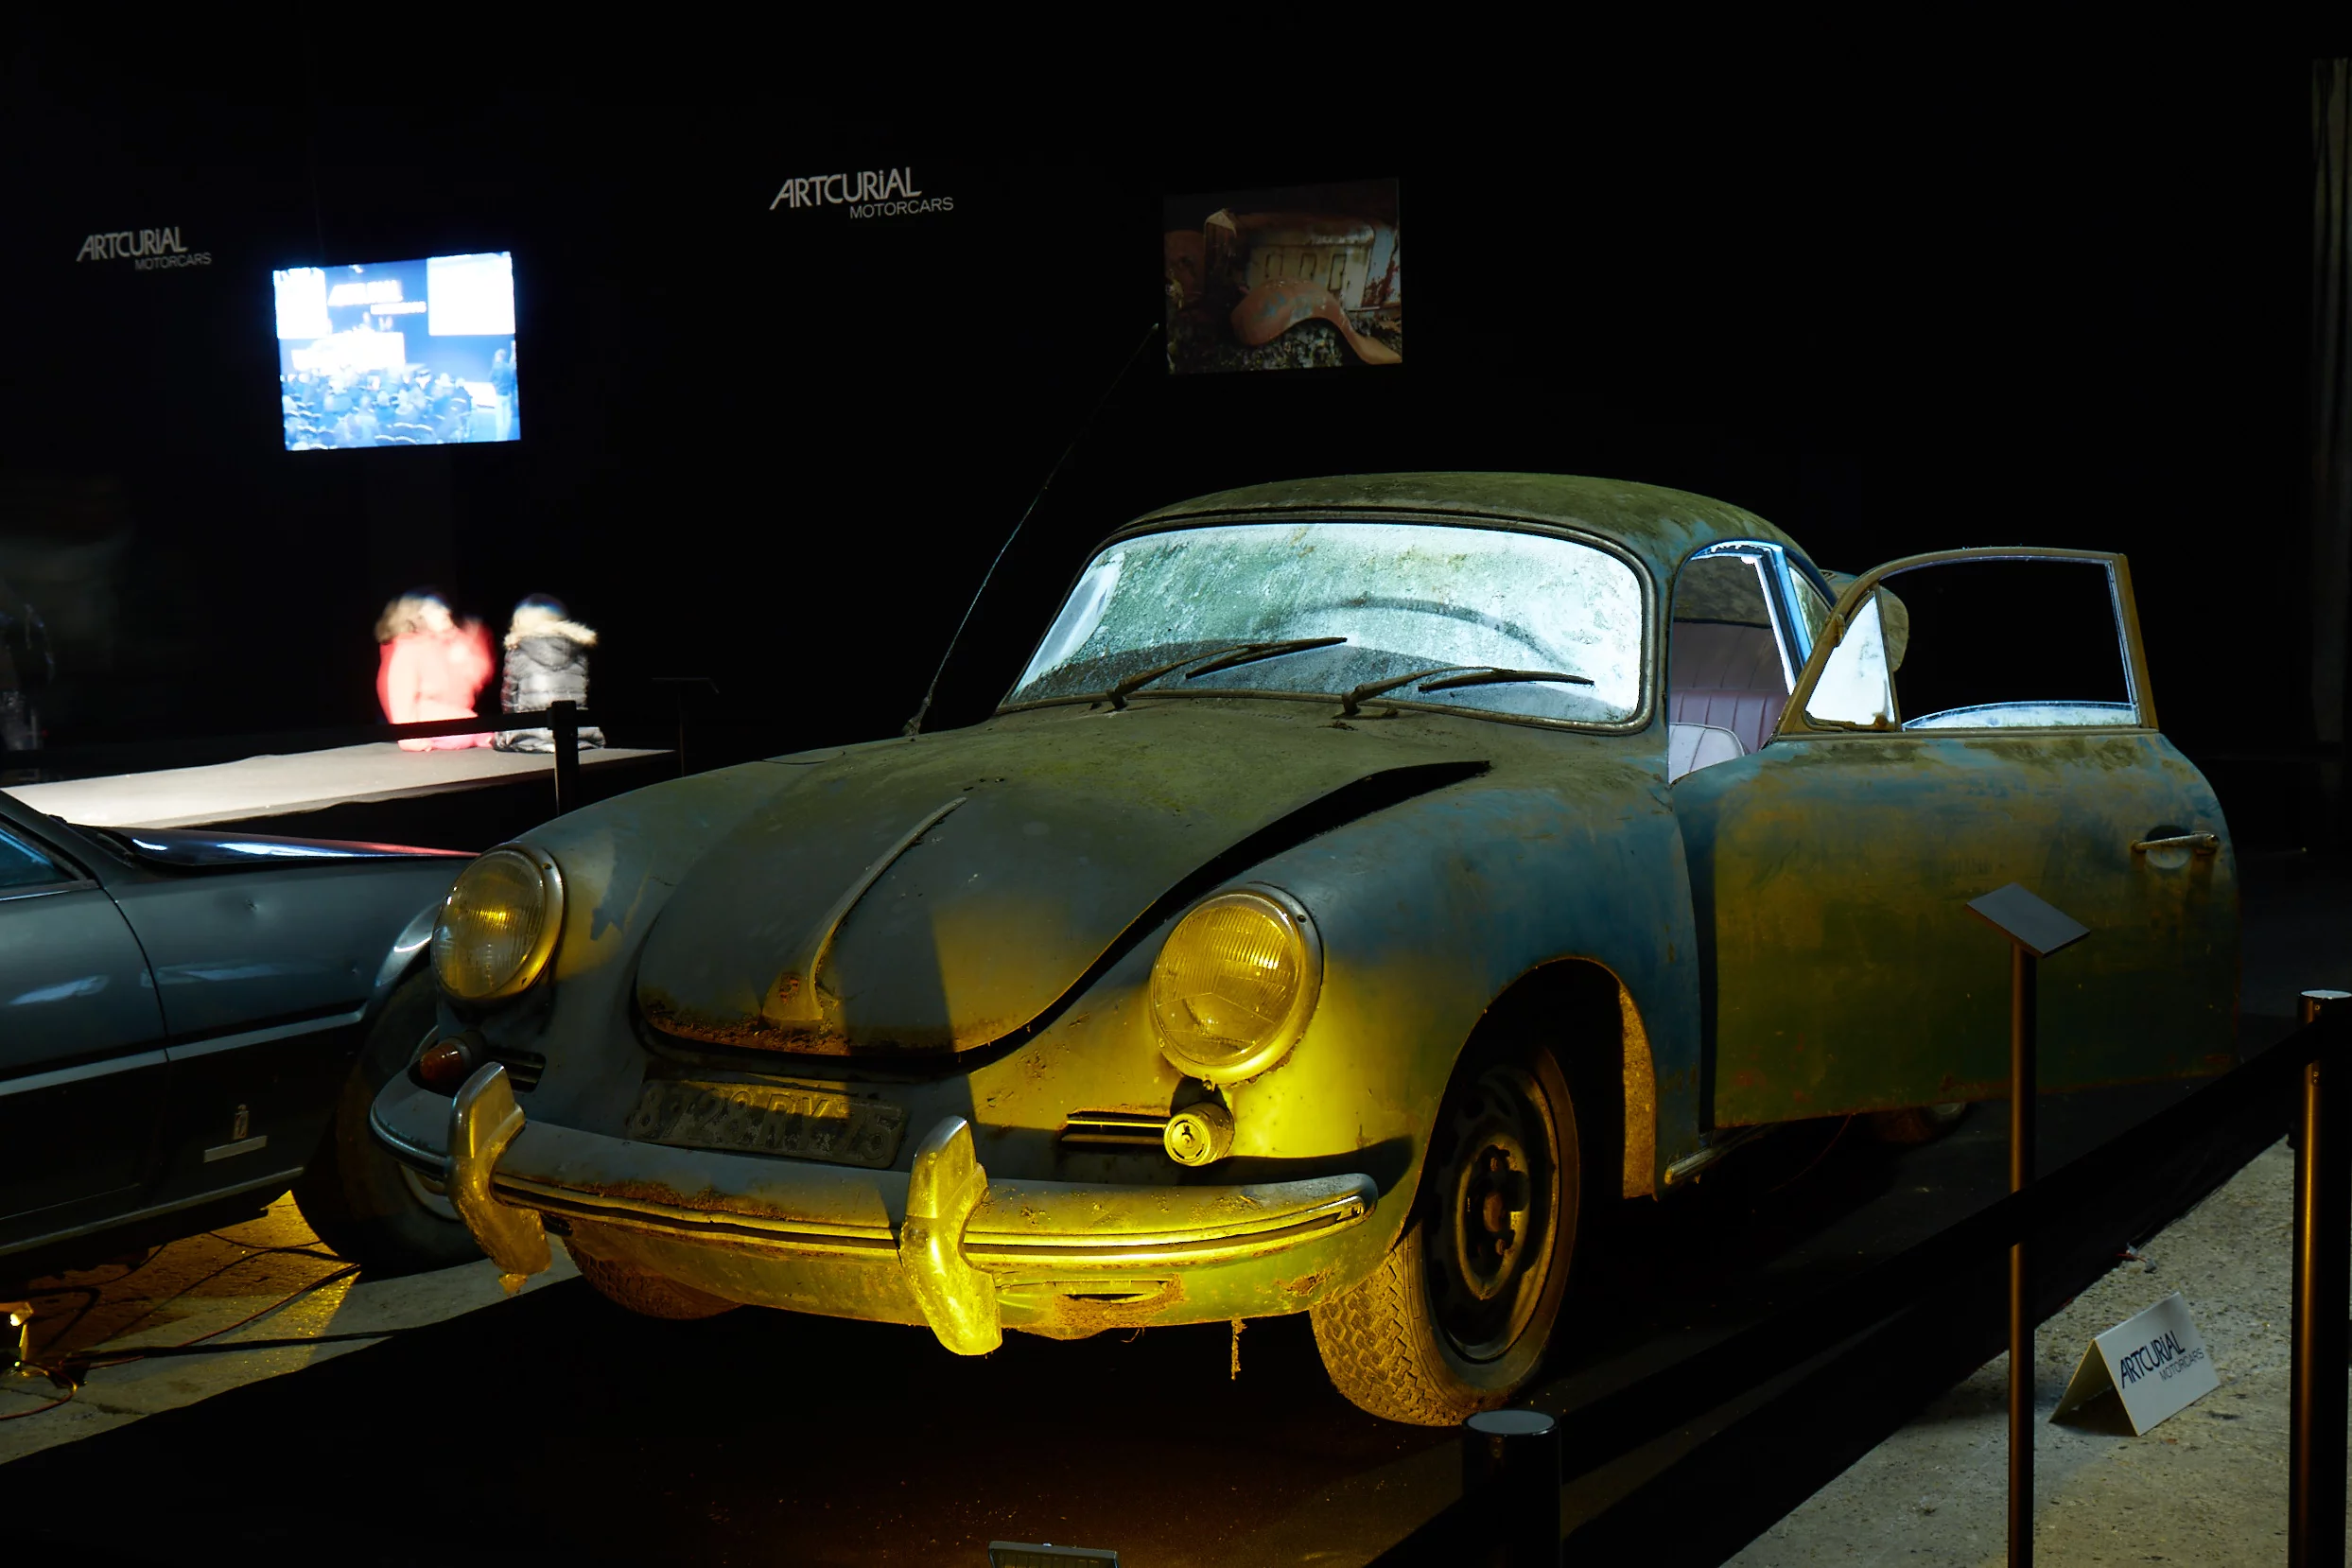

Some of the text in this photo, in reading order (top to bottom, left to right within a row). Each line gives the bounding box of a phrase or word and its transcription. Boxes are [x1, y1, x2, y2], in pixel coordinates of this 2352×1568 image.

[850, 197, 954, 219] MOTORCARS
[134, 252, 213, 271] MOTORCARS
[2159, 1348, 2205, 1383] MOTORCARS
